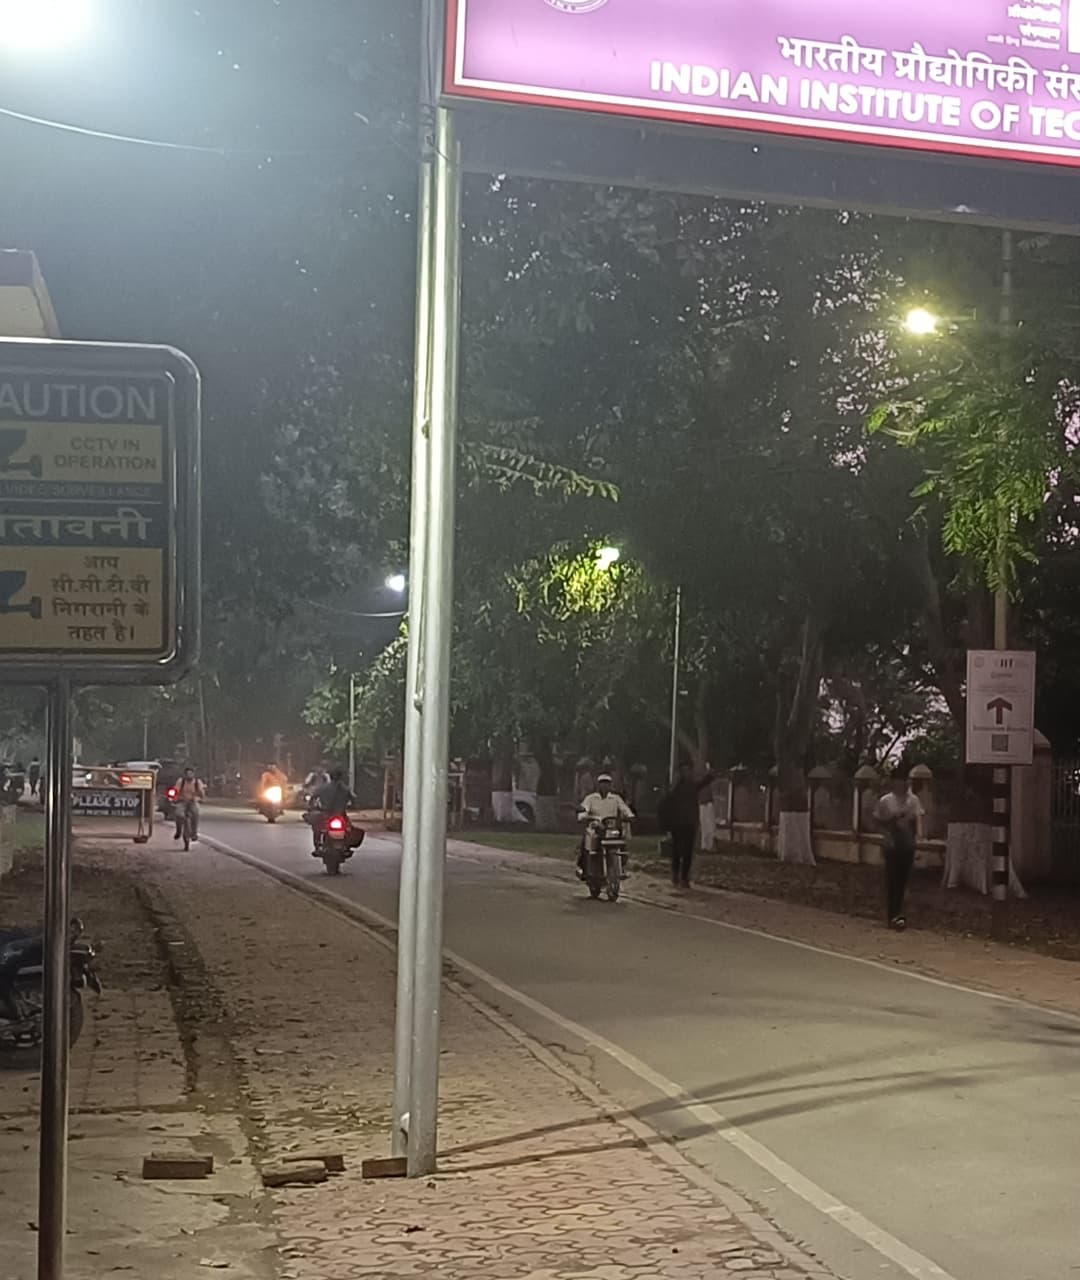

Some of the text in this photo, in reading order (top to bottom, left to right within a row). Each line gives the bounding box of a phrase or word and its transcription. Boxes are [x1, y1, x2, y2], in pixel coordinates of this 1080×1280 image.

[776, 33, 888, 78] भारतीय
[892, 41, 1038, 96] प्रौद्योगिकी
[650, 60, 788, 106] INDIAN
[799, 78, 961, 127] INSTITUTE
[969, 99, 1020, 132] OF
[0, 381, 156, 419] AUTION
[70, 437, 141, 451] CCTV IN
[54, 454, 157, 470] OPERATION
[0, 507, 152, 540] तावनी
[83, 555, 120, 569] आप
[67, 625, 107, 641] तहत
[113, 797, 140, 807] STOP
